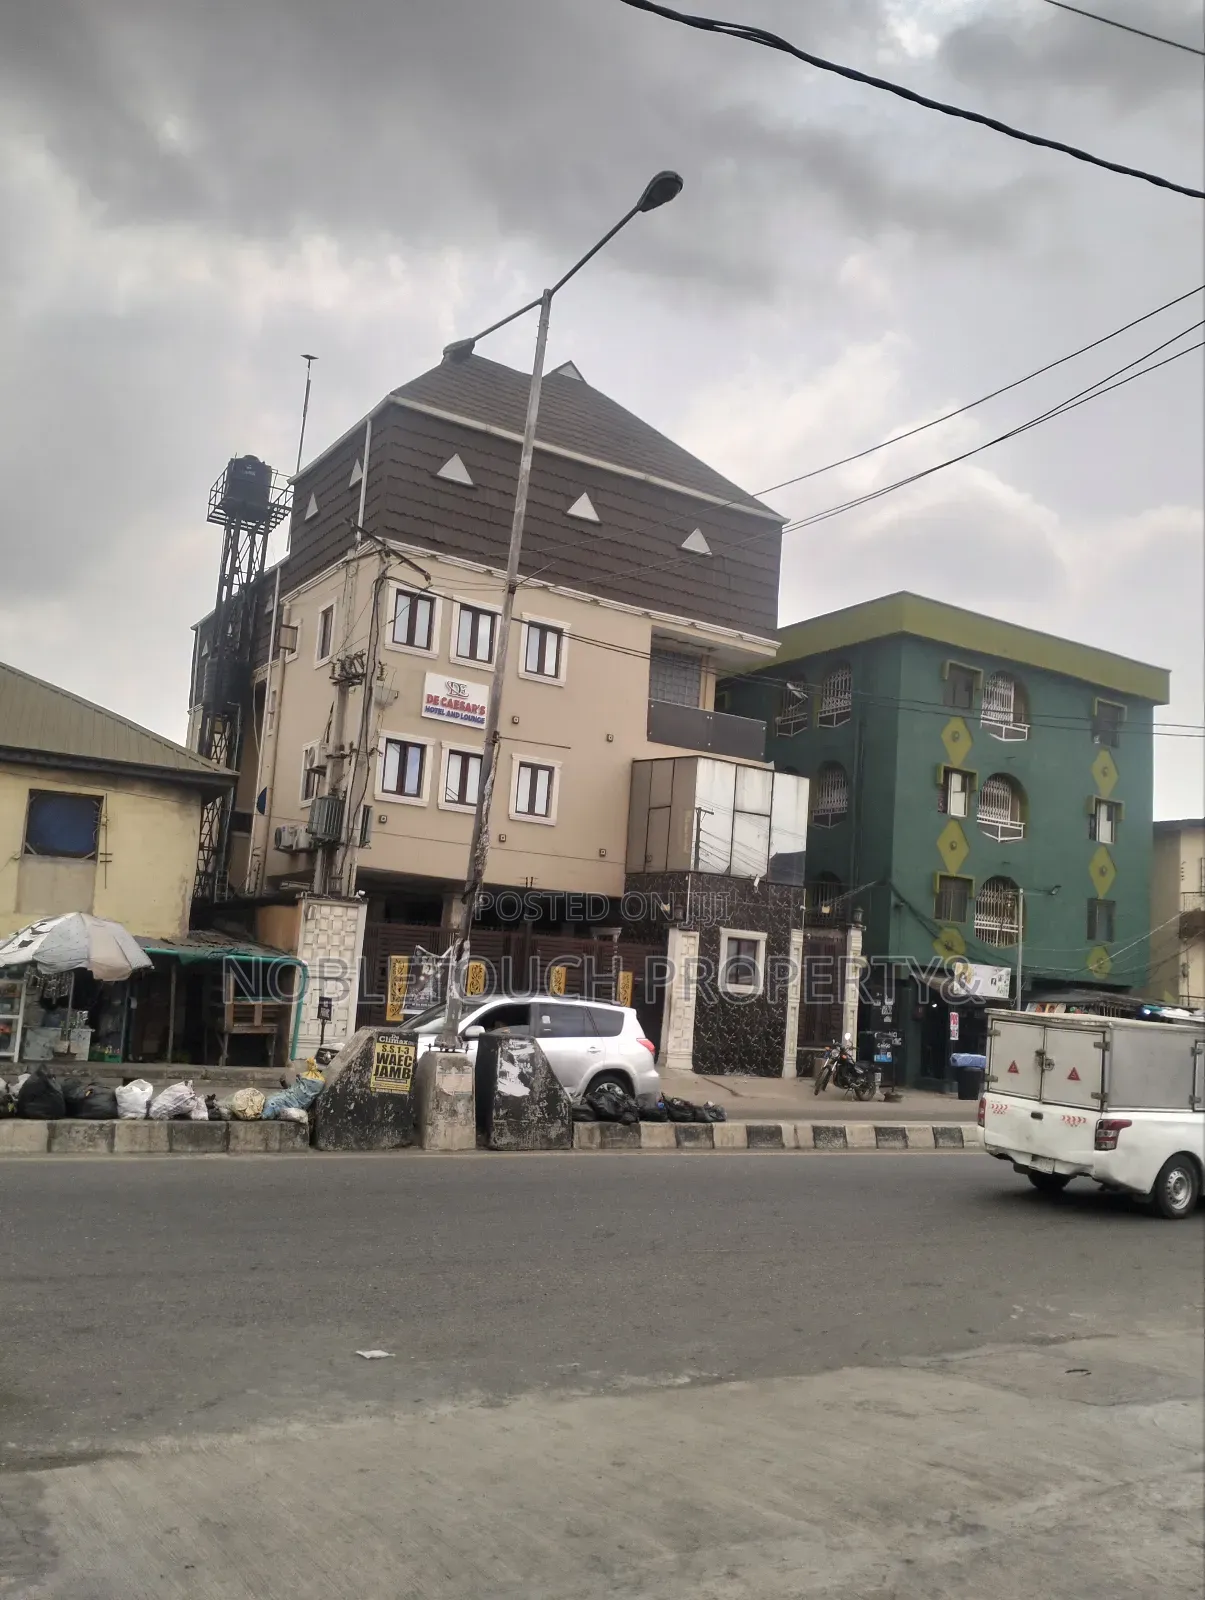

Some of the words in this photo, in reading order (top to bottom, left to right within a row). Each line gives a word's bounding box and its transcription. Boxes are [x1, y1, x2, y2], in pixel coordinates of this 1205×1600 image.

[426, 694, 440, 705] DE
[441, 697, 486, 715] CAESAR'S
[425, 706, 445, 715] HOTEL
[460, 713, 485, 724] LOUNGE
[379, 1036, 408, 1045] Climax
[381, 1044, 410, 1055] S.S.1-3
[376, 1052, 413, 1068] WAEC
[374, 1065, 411, 1080] JAMB
